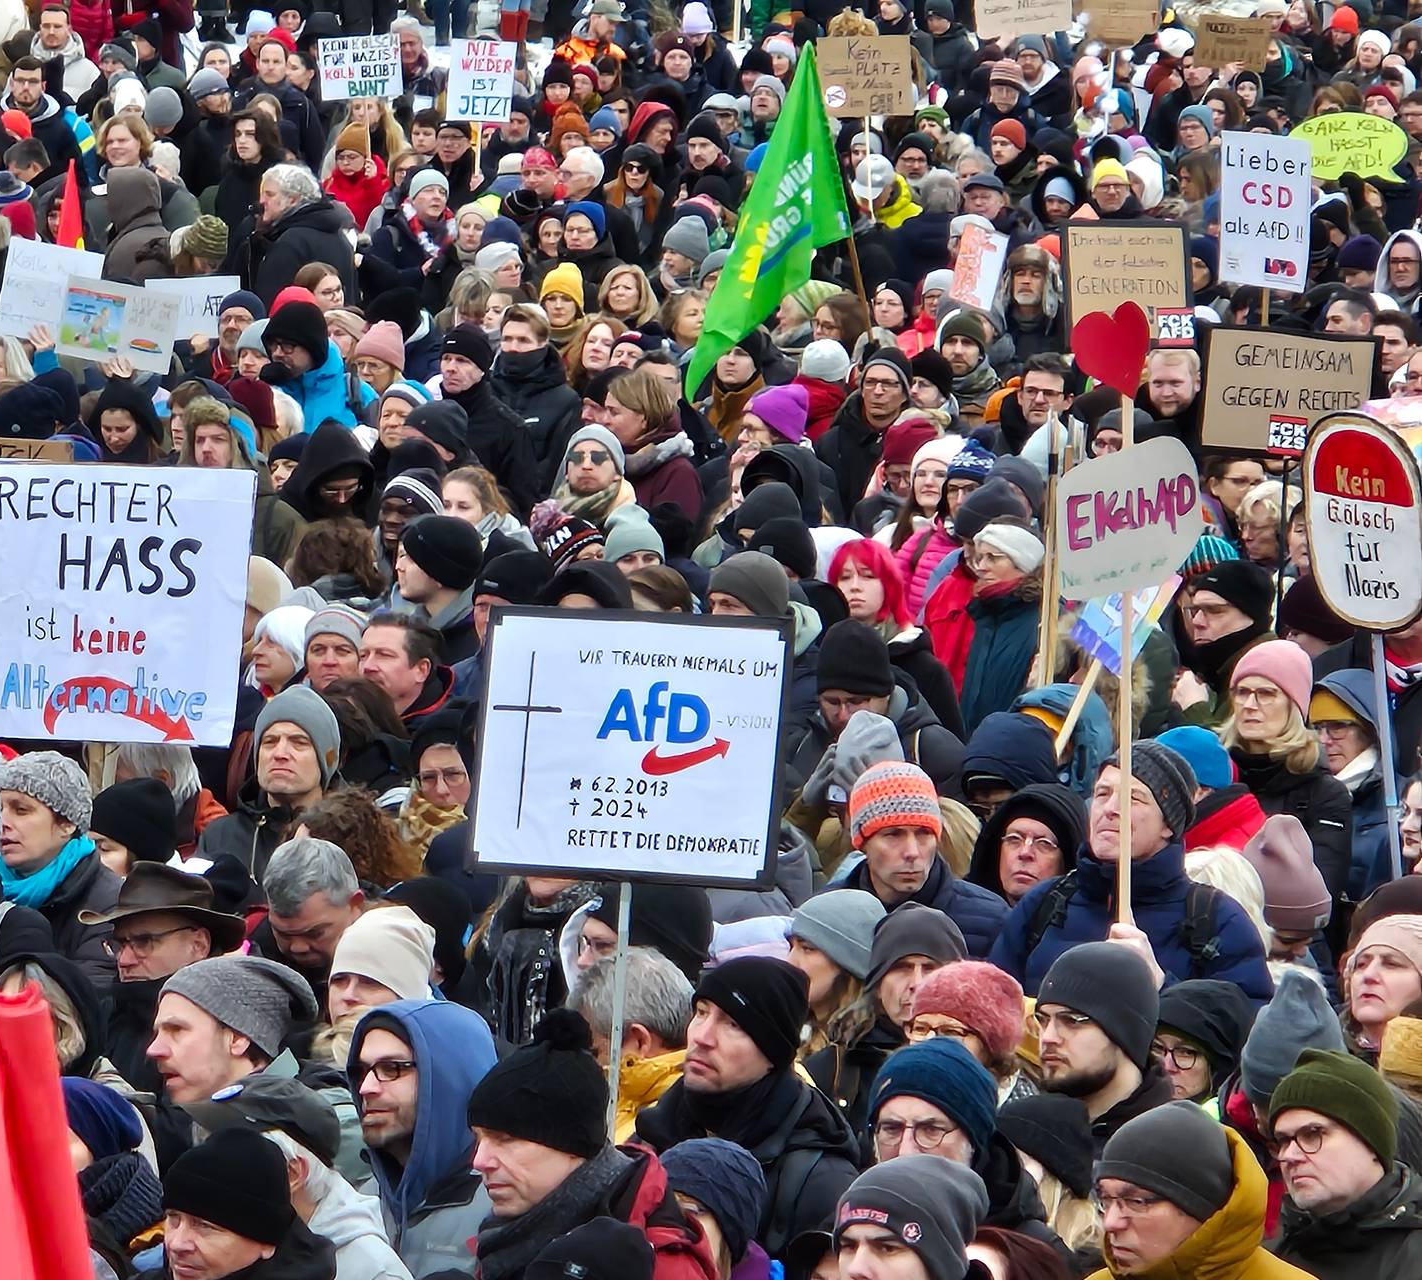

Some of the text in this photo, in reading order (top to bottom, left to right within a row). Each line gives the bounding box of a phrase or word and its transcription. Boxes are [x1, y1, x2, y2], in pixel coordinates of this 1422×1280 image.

[467, 41, 500, 57] NIE
[461, 58, 513, 73] WIEDER
[856, 61, 900, 76] PLATZ
[348, 79, 389, 96] BUNT
[472, 78, 498, 91] IST
[458, 95, 510, 117] JETZT
[1302, 119, 1393, 136] GANZ KÖLN
[1226, 144, 1307, 177] Lieber
[1241, 181, 1293, 209] CSD
[1225, 216, 1250, 235] als
[1255, 221, 1290, 240] AfD
[1076, 275, 1179, 295] GENERATION
[1157, 314, 1194, 328] FCK
[1158, 326, 1194, 339] AFD
[1235, 343, 1354, 375] GEMEINSAM
[1222, 385, 1361, 411] GEGEN RECHTS
[1269, 421, 1308, 437] FCK
[1268, 435, 1306, 450] NZS
[1335, 464, 1385, 498] Kein
[1345, 532, 1381, 562] für
[58, 533, 202, 598] HASS
[1345, 563, 1400, 600] Nazis
[26, 605, 147, 655] ist keine
[579, 649, 779, 678] WIR TRAUERN NIEMALS UM
[0, 662, 208, 721] Alternative
[596, 681, 711, 744] AfD
[591, 776, 669, 798] 6.2.2013
[591, 798, 648, 819] 2024
[566, 829, 761, 856] RETTET DIE DEMOKRATIE
